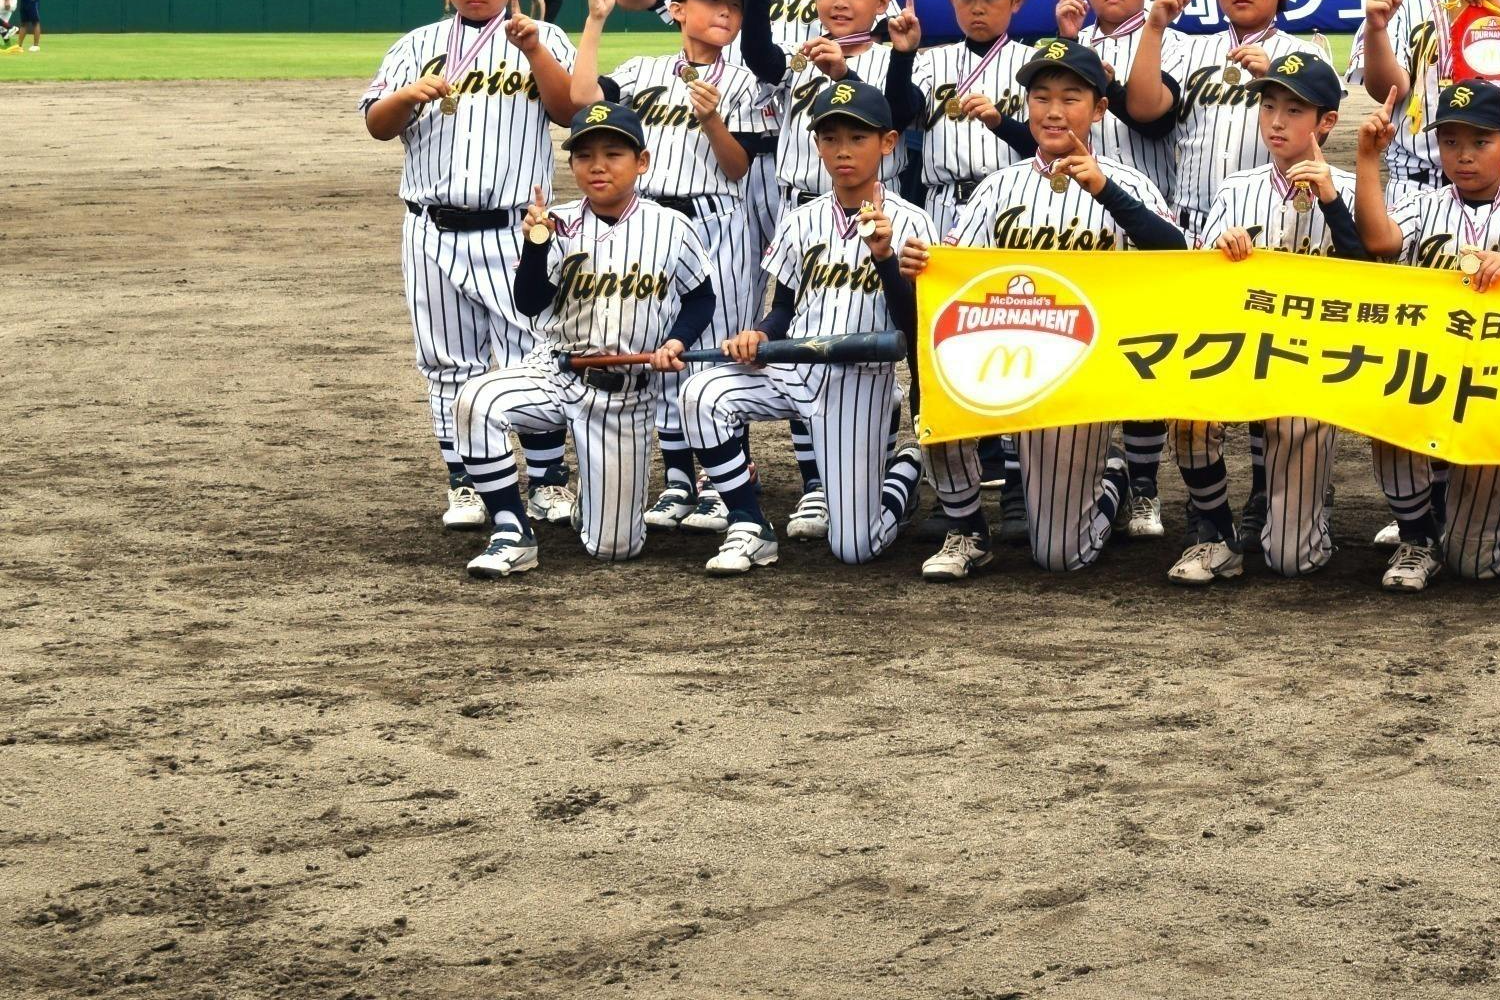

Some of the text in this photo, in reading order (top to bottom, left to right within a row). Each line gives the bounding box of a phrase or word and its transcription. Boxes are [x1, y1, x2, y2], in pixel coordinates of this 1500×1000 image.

[554, 251, 669, 316] Junior
[795, 243, 885, 309] Junio
[990, 295, 1051, 306] McDonald's
[1244, 289, 1428, 326] 高円宮賜杯
[956, 305, 1080, 334] TOURNAMENT
